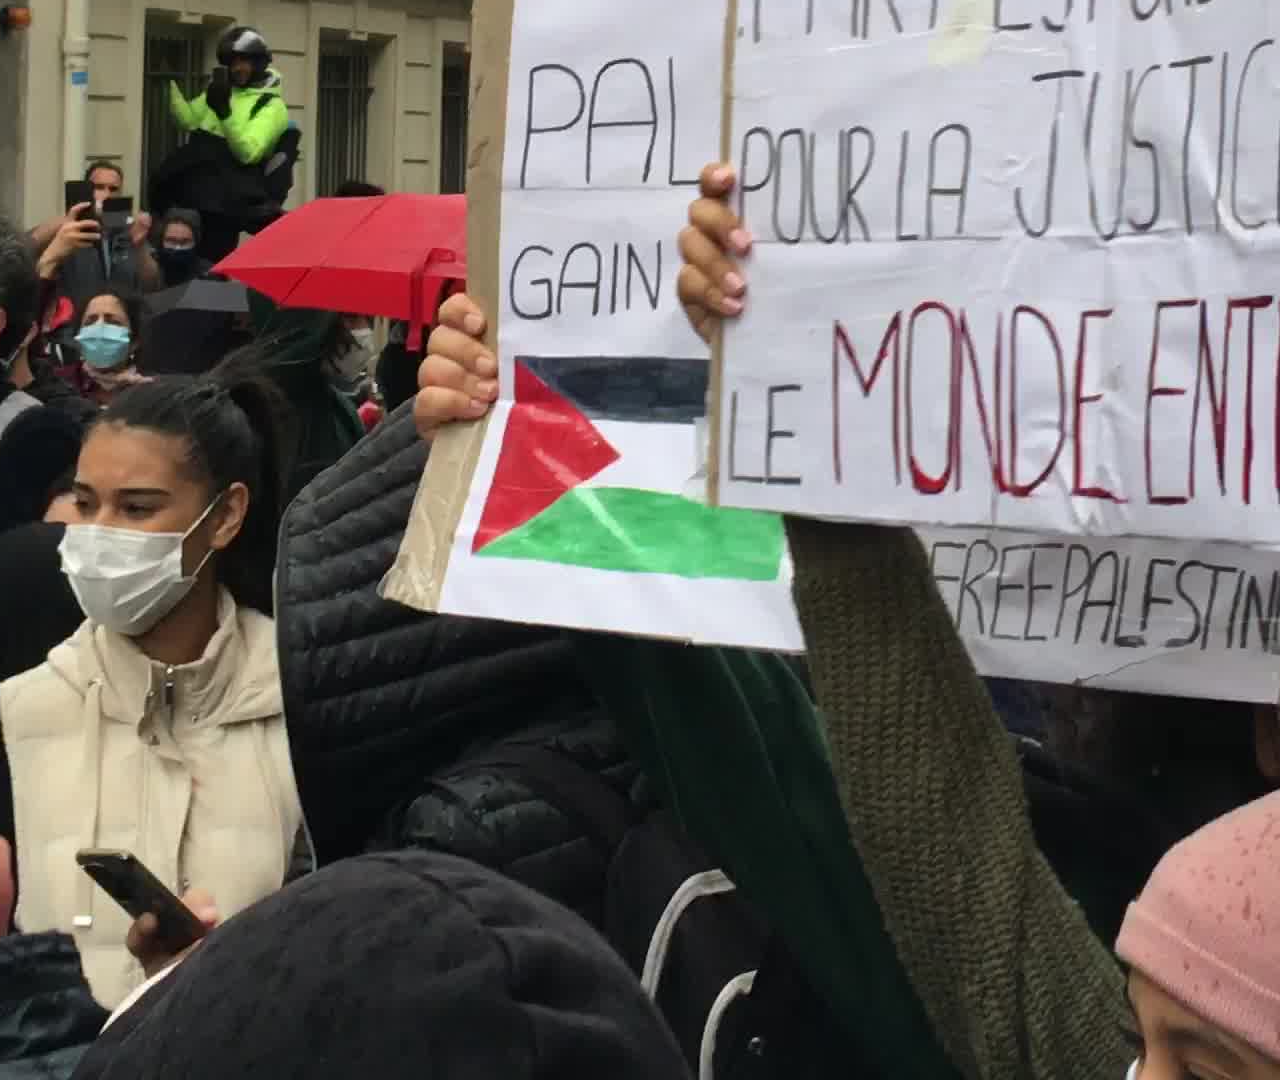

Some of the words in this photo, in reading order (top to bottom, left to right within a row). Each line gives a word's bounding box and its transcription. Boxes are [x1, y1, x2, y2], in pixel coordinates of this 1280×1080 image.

[519, 56, 704, 189] PAL
[738, 124, 872, 244] POUR
[895, 122, 973, 242] LA
[729, 383, 803, 485] LE
[832, 300, 1127, 503] MONDE
